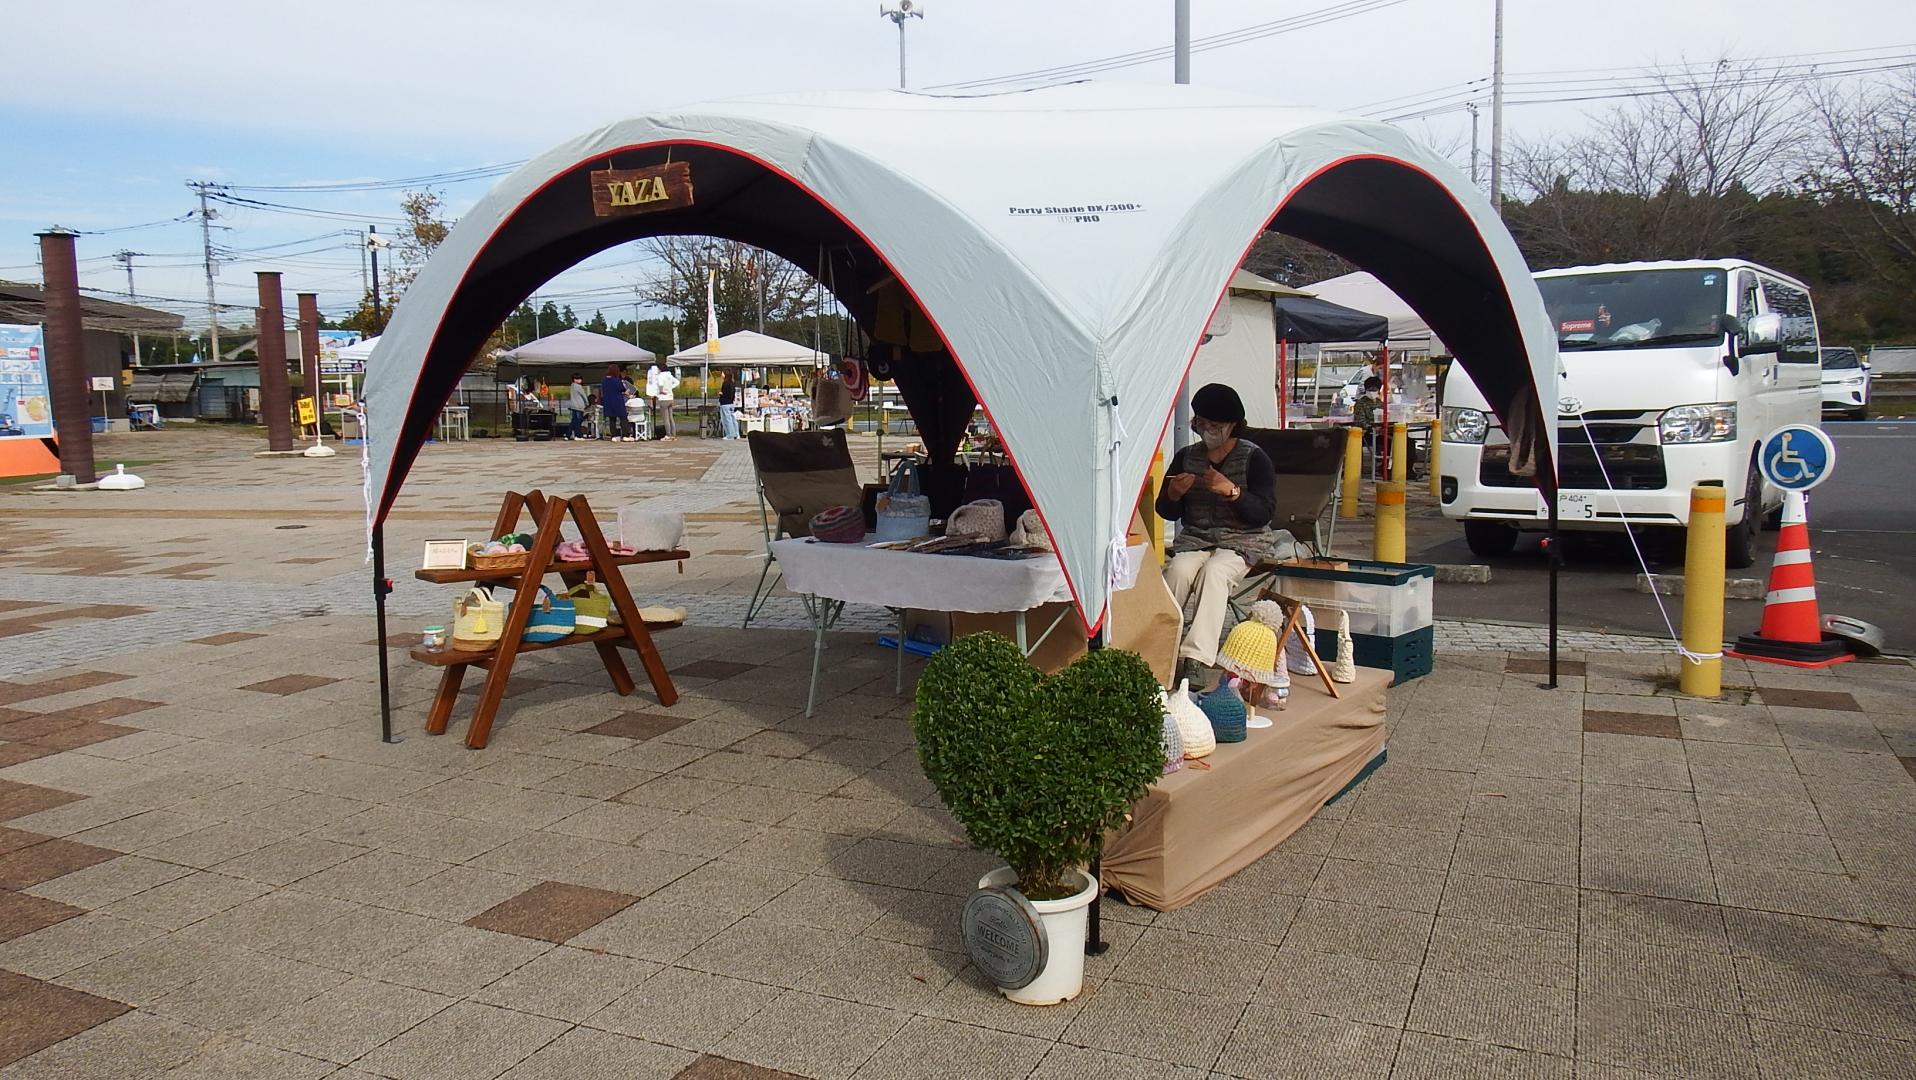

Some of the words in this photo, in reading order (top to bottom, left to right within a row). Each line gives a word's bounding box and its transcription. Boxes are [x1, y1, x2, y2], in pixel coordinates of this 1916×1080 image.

[608, 176, 669, 206] YAZA
[1009, 206, 1042, 214] Party
[1045, 205, 1085, 214] Shade
[1561, 322, 1592, 331] Supreme
[977, 924, 1020, 955] WELCOME
